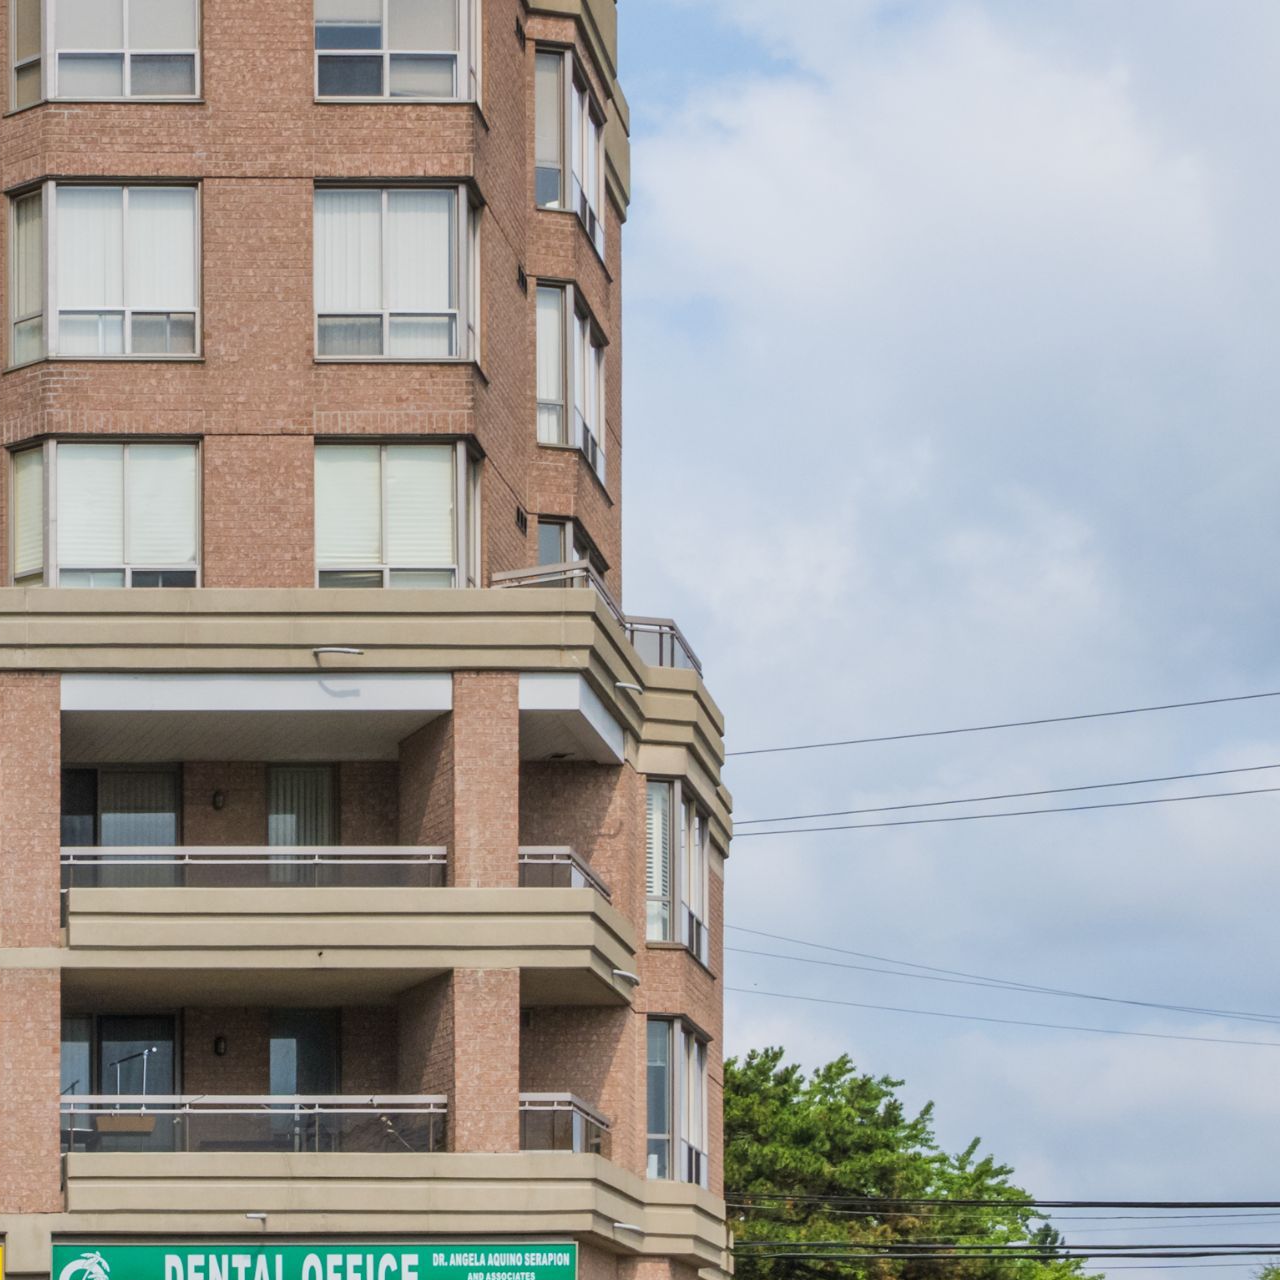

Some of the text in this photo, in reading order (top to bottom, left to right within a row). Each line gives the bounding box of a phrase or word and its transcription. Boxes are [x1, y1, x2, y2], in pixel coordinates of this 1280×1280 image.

[432, 1252, 571, 1267] DR. ANGELA AQUINO SERAPION
[467, 1271, 536, 1280] AND ASSOCIATES
